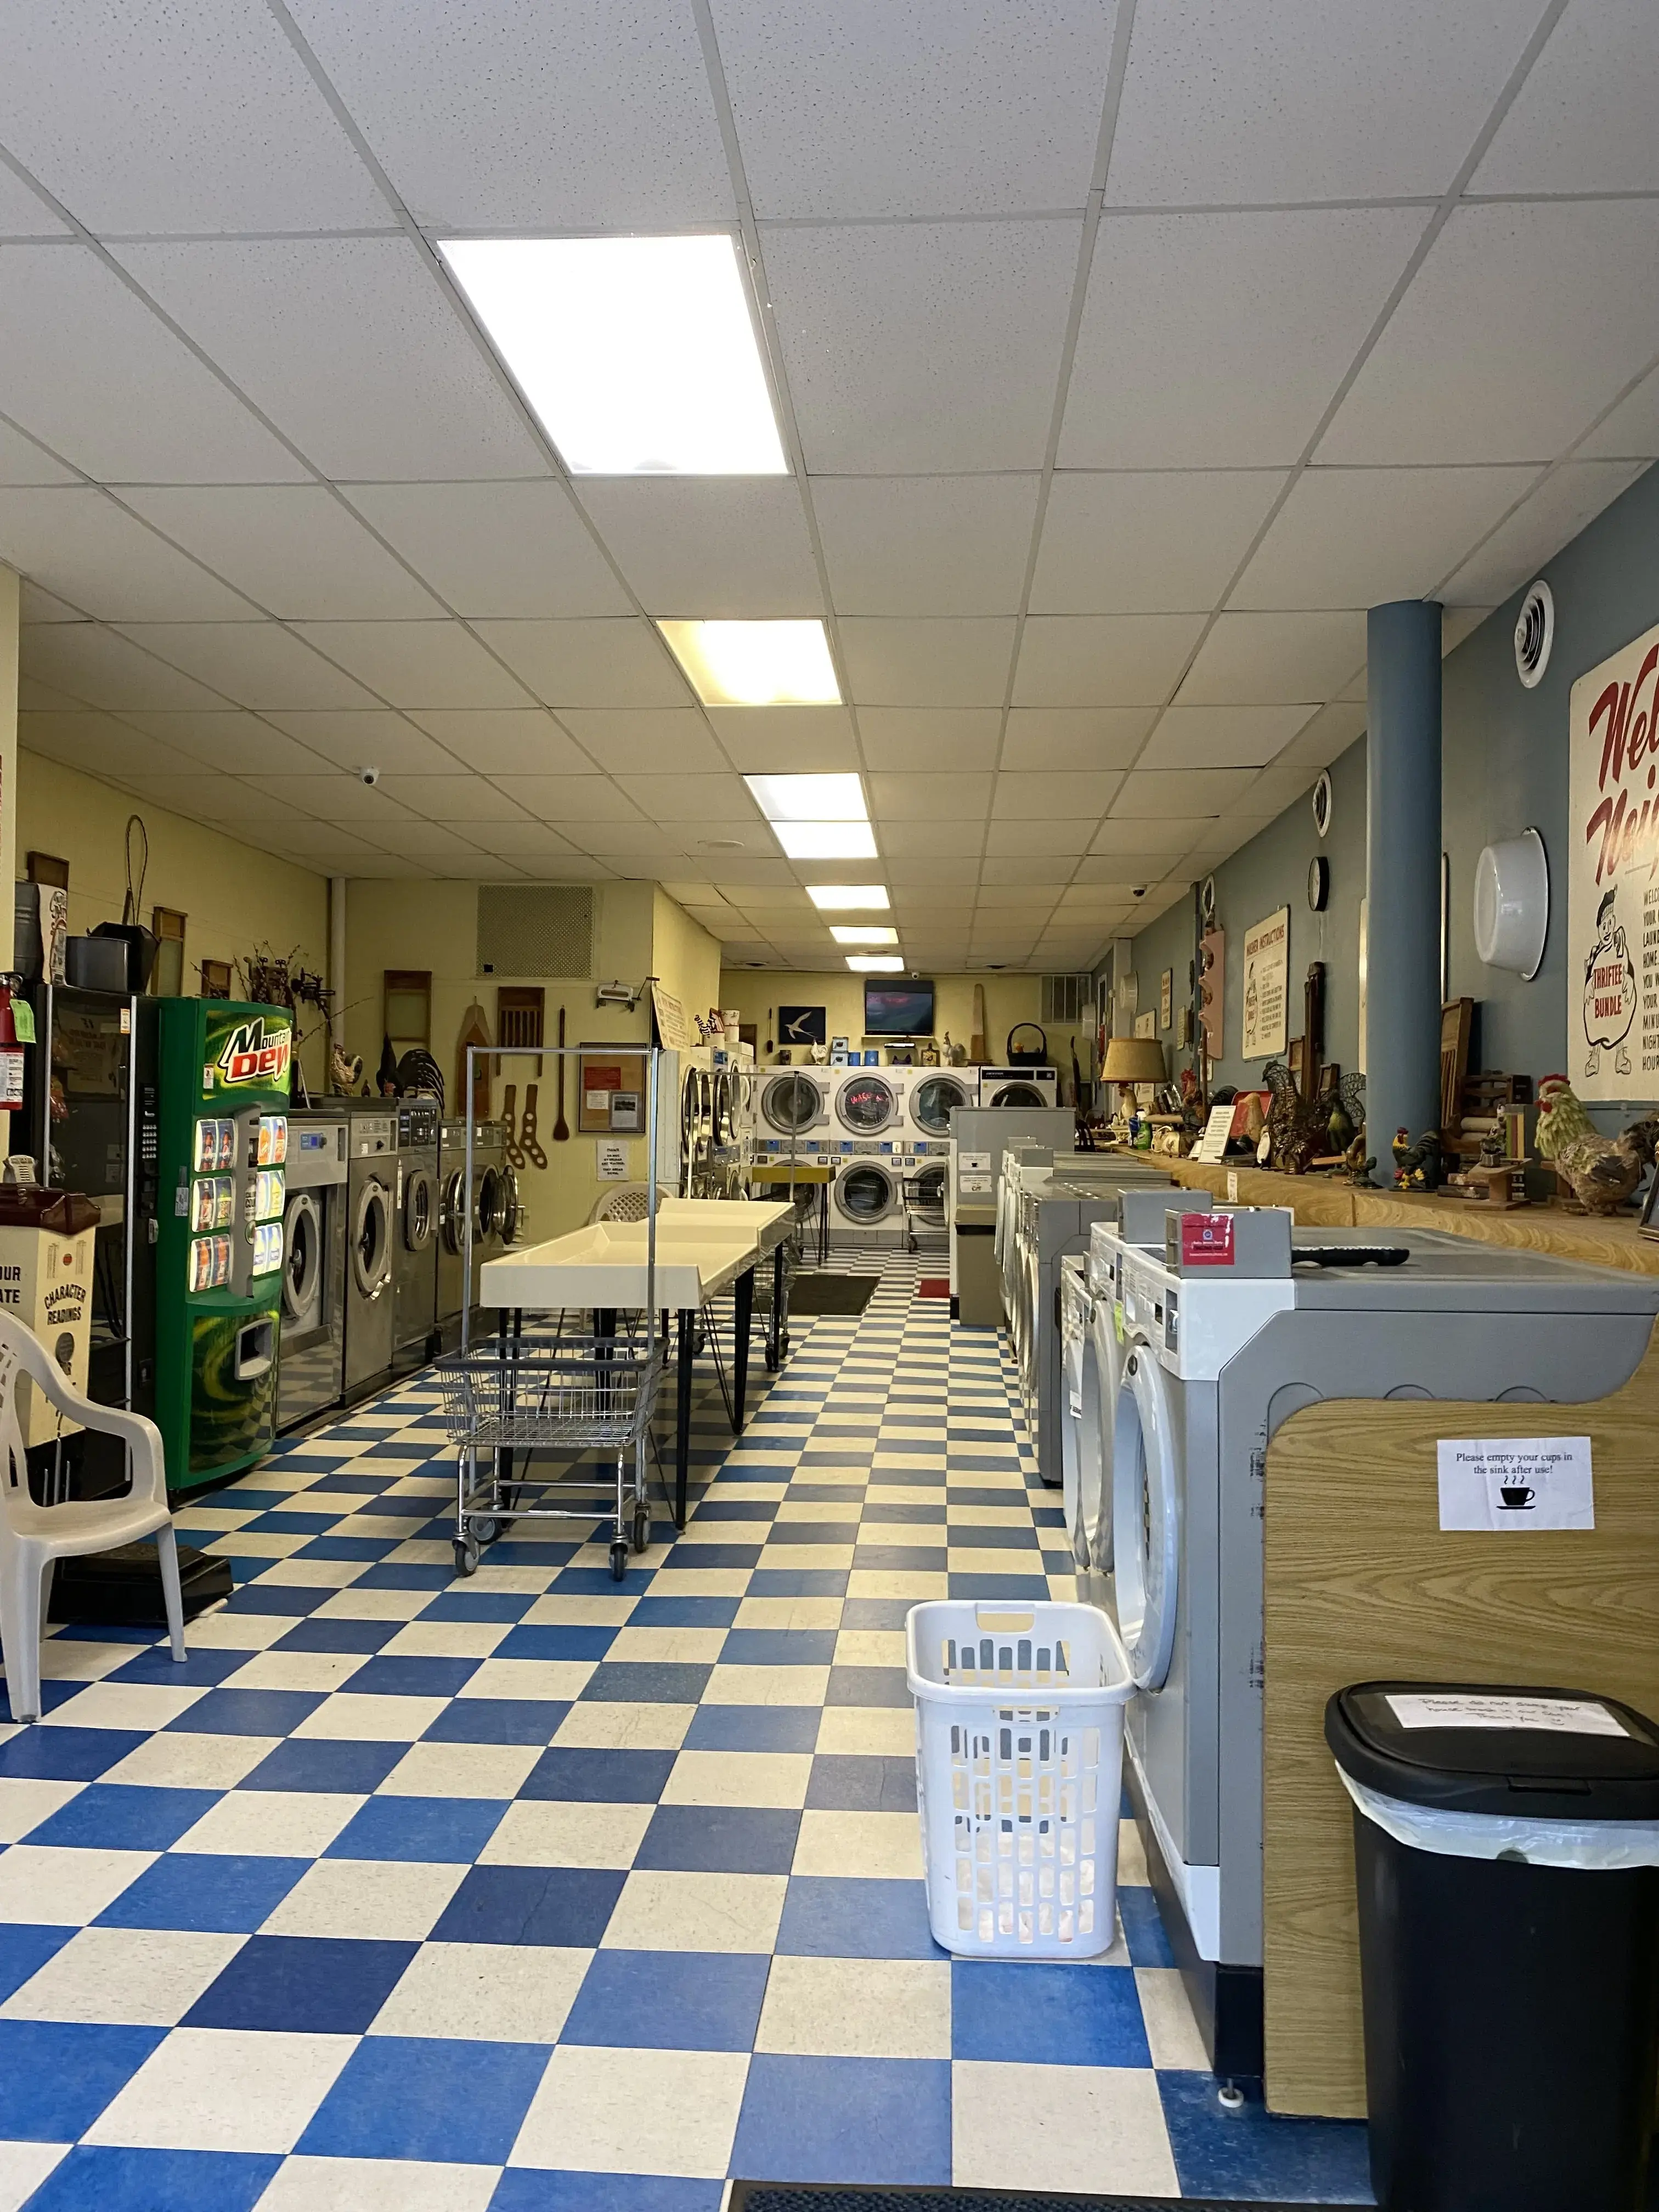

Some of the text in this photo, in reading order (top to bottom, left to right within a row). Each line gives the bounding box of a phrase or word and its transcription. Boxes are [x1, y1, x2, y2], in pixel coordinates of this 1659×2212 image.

[1594, 963, 1622, 989] THRIFTEE
[1595, 995, 1622, 1019] BUNDLE
[44, 1284, 86, 1310] CHARACTER
[1456, 1452, 1572, 1463] Please empty your cups in
[1474, 1465, 1553, 1474] the sink after use!
